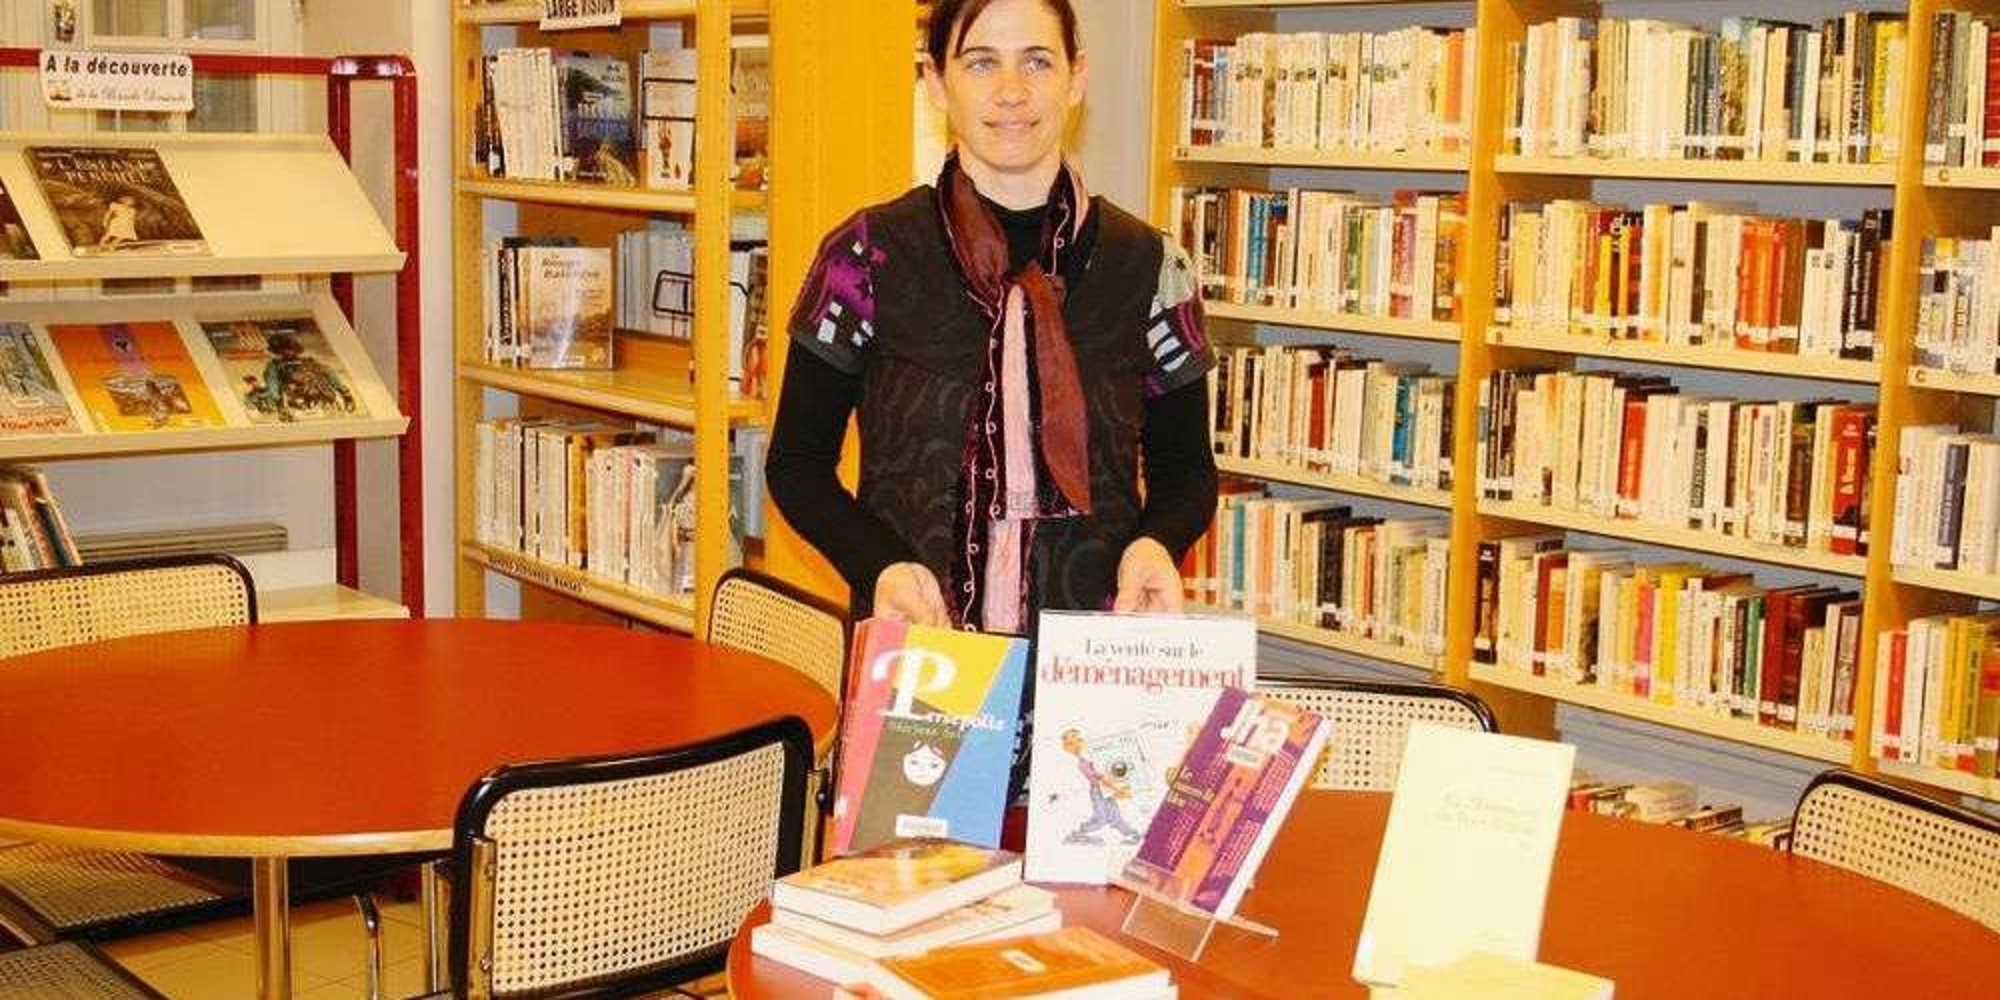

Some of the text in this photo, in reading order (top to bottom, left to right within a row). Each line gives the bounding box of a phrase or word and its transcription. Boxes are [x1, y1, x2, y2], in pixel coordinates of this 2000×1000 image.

[46, 54, 188, 77] A la découverte
[1041, 655, 1244, 694] déménagement
[1220, 699, 1290, 755] Jha
